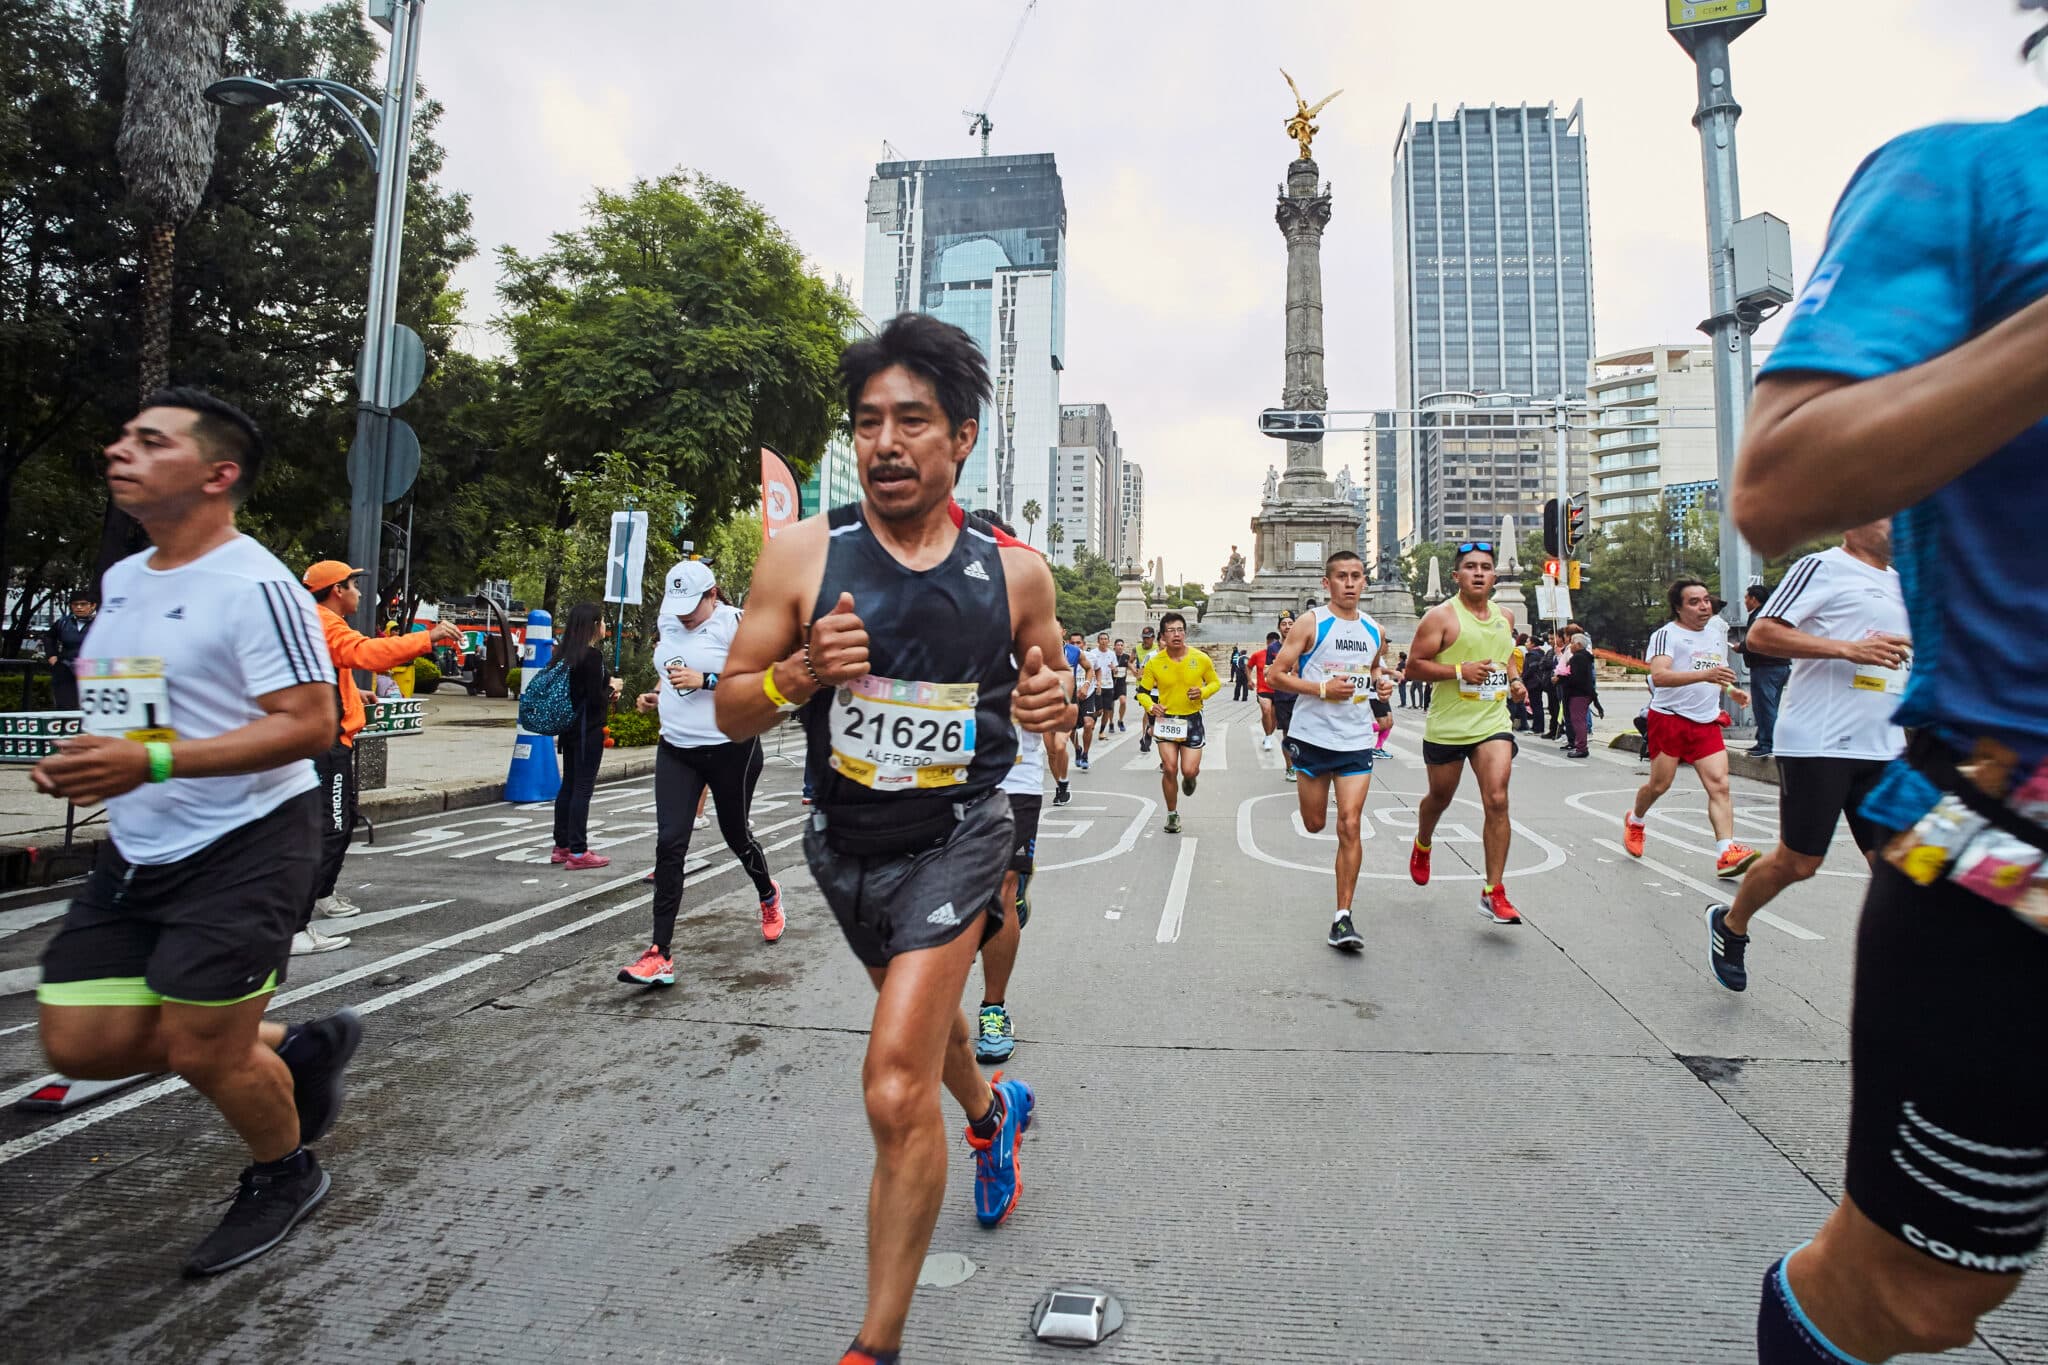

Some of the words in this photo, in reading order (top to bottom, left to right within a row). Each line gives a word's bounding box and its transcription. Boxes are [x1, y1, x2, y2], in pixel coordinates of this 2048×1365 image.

[1702, 6, 1728, 15] CDMX
[674, 579, 681, 588] G
[1336, 639, 1368, 652] MARINA
[1694, 661, 1720, 671] 3760
[1484, 672, 1503, 686] 823
[844, 707, 962, 752] 21626
[1160, 725, 1181, 735] 3589
[865, 749, 933, 767] ALFREDO
[333, 773, 343, 831] GATORADE
